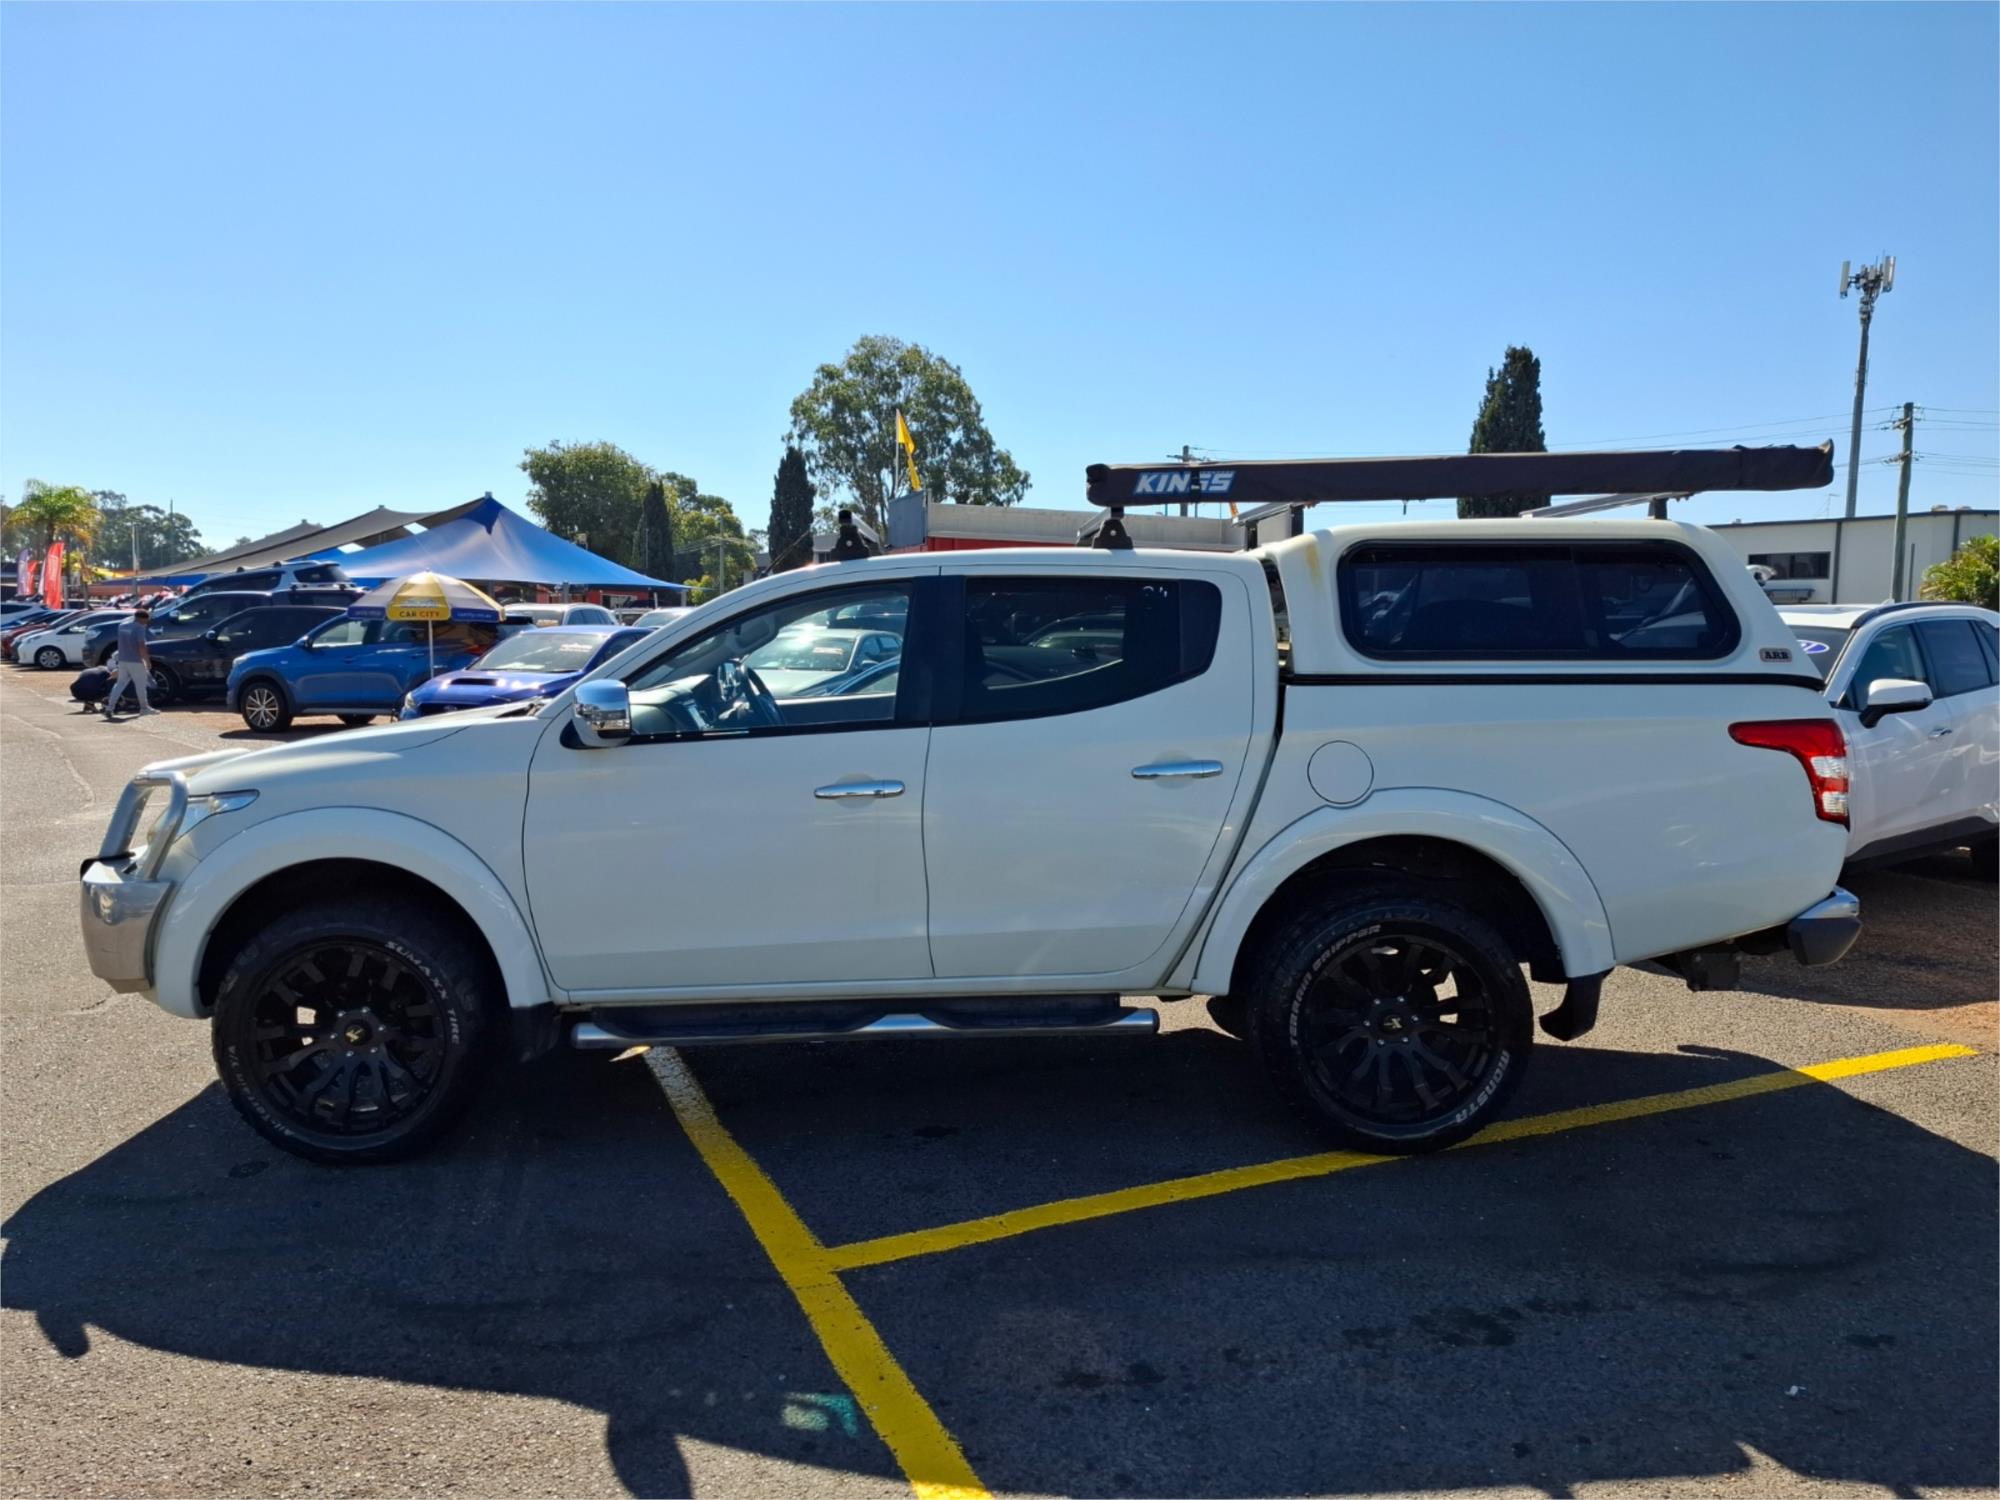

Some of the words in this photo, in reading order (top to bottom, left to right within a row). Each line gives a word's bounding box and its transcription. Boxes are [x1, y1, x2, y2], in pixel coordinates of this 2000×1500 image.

[1765, 651, 1788, 660] ARB
[1289, 971, 1313, 1047] TERRAIN
[1311, 923, 1382, 970] GRIPPER
